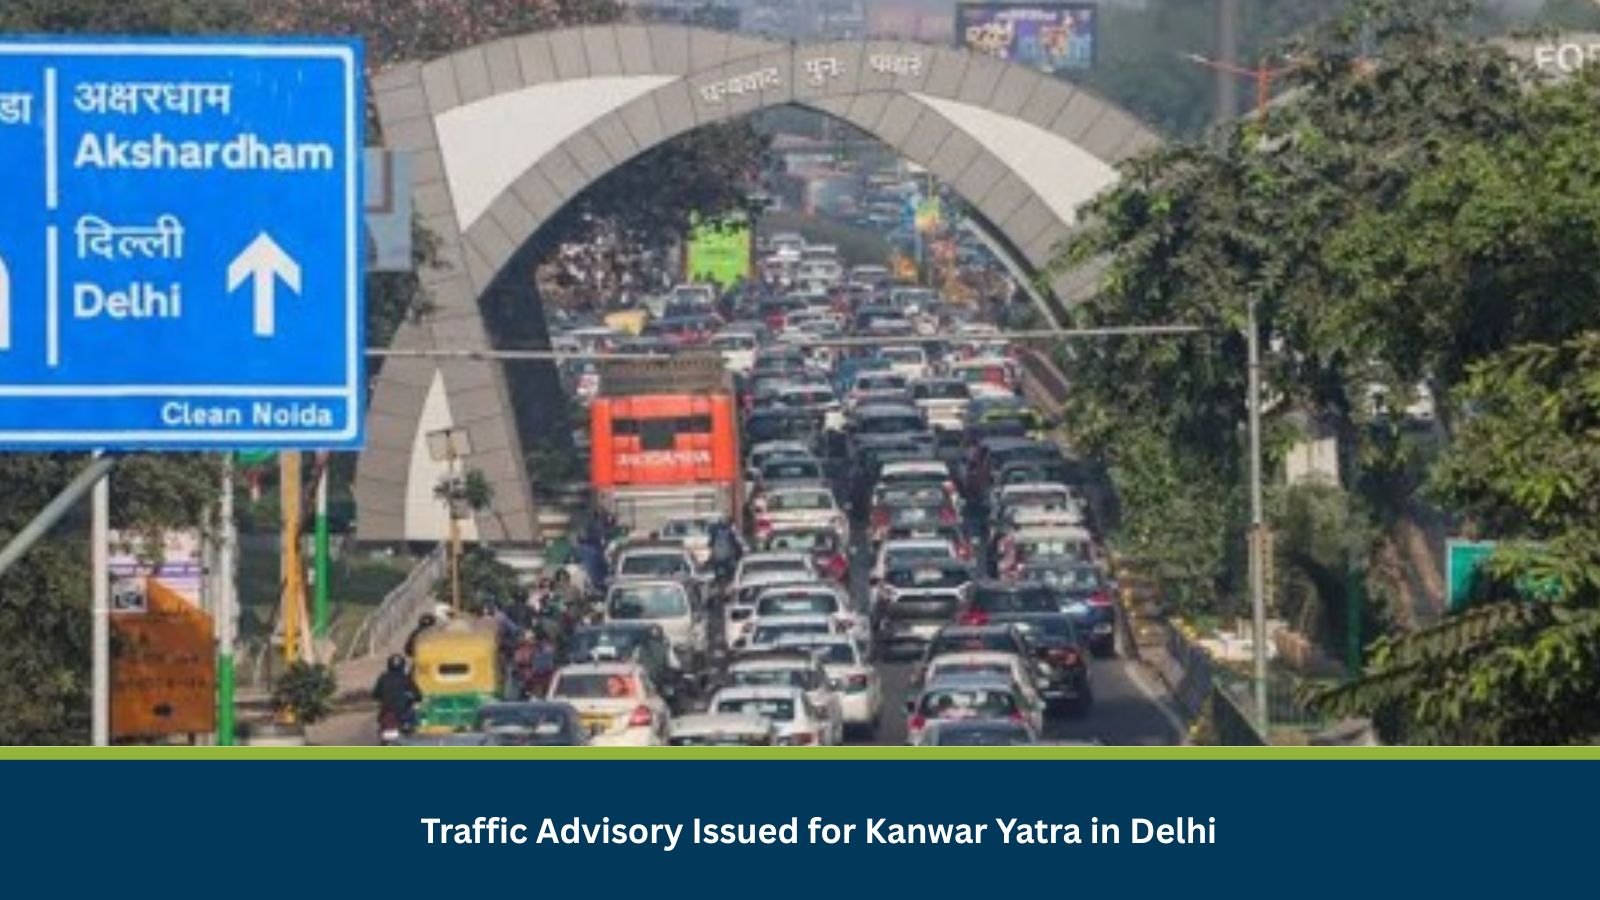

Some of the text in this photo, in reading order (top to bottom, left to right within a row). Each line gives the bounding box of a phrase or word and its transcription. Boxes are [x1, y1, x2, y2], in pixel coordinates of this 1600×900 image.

[74, 82, 232, 115] अक्षरधाम
[74, 133, 333, 169] Akshardham
[75, 215, 184, 259] दिल्ली
[74, 283, 181, 318] Delhi
[162, 402, 332, 425] Clean Noida
